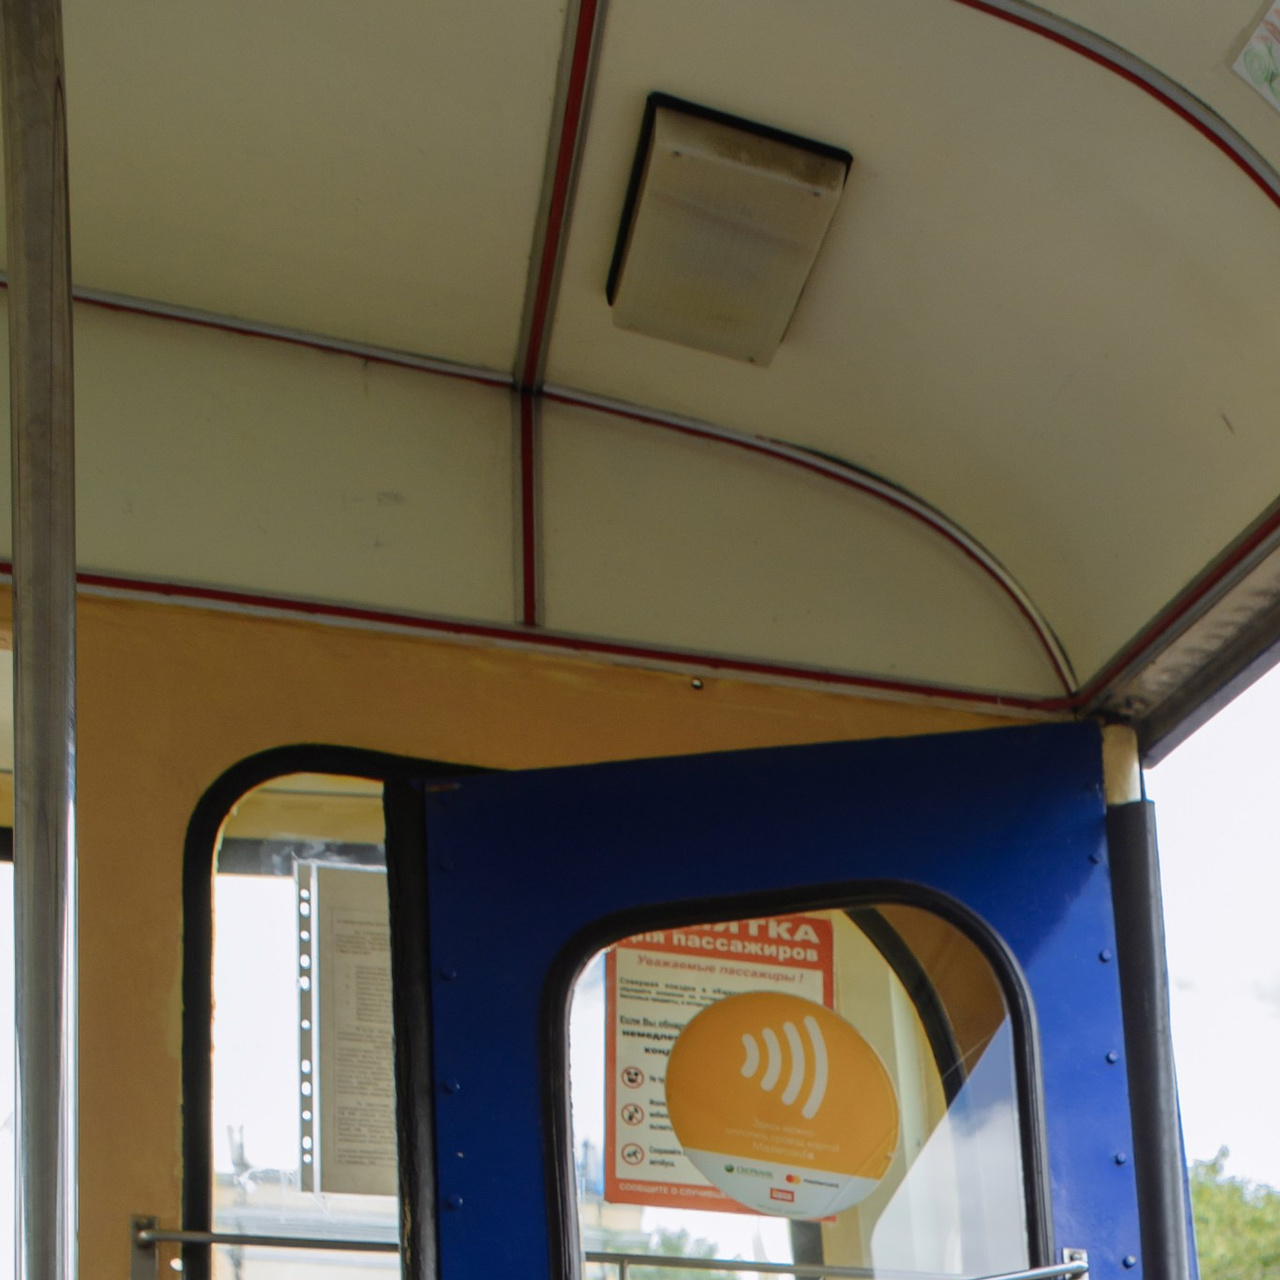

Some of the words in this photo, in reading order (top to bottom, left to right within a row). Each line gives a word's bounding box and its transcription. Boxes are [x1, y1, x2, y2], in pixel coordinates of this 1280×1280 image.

[673, 932, 818, 962] пассажиров
[637, 955, 715, 973] Уважаемые
[720, 966, 796, 984] пассажиры
